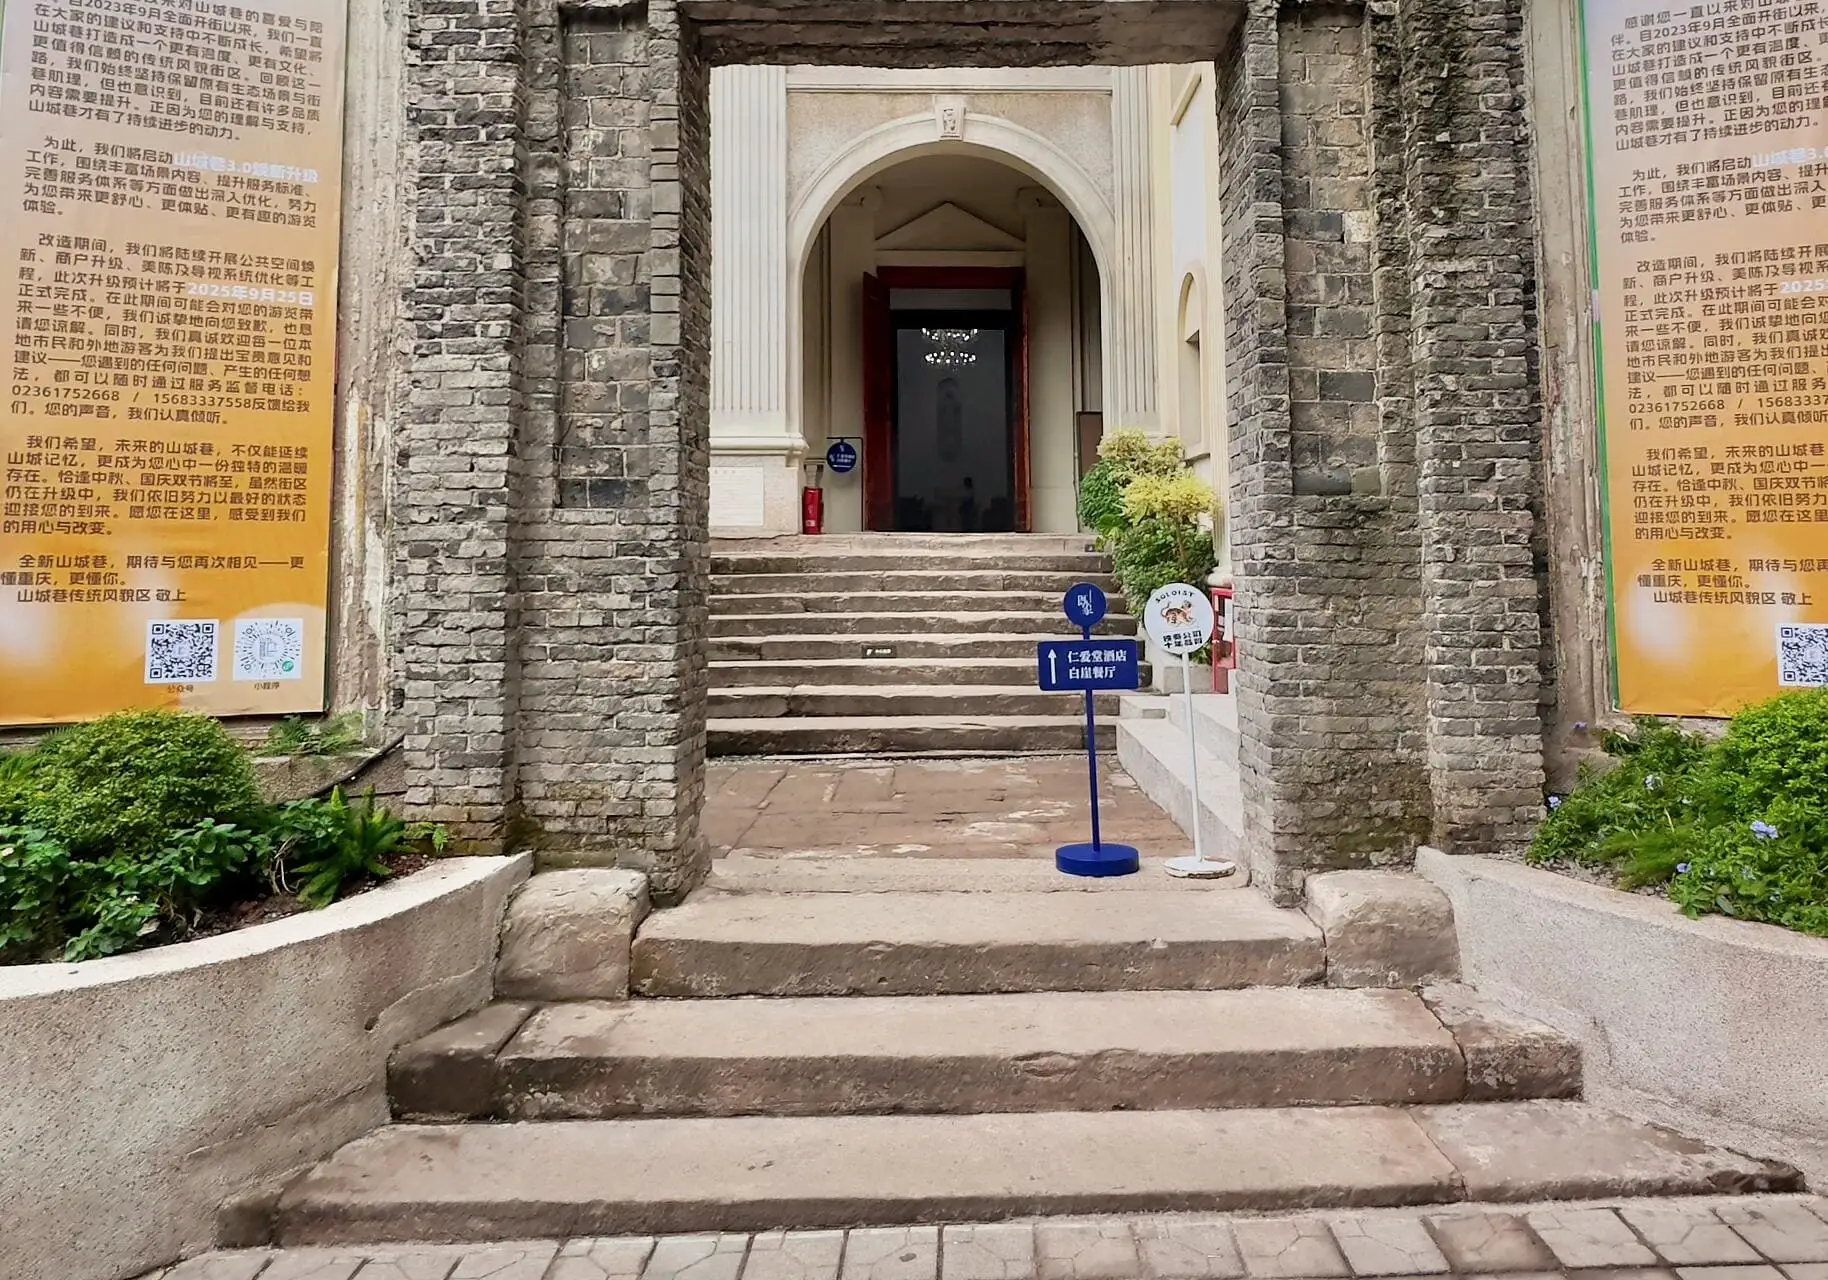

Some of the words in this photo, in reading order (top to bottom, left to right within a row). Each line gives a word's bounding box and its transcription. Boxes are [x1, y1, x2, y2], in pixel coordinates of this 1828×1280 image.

[1615, 112, 1819, 152] 山城巷才有了持续进步的动力。
[21, 197, 65, 216] 体验。
[1619, 227, 1656, 245] 体验。
[1622, 276, 1828, 308] 程，此次升级预计将于2025
[1626, 358, 1828, 386] 建议——您遇到的任何问题、
[11, 382, 120, 403] 02361752668
[9, 399, 228, 425] 们。您的声音，我们认真倾听。
[1627, 397, 1725, 416] 02361752668
[1632, 488, 1827, 511] 仍在升级中，我们依旧努力
[2, 518, 113, 536] 的用心与改变。
[1634, 524, 1732, 541] 的用心与改变。
[16, 587, 151, 604] 山城巷传统风貌区
[155, 587, 187, 603] 敬上
[1652, 589, 1777, 606] 山城巷传统风貌区
[1780, 590, 1813, 606] 敬上
[1067, 650, 1127, 663] 仁爱堂酒店
